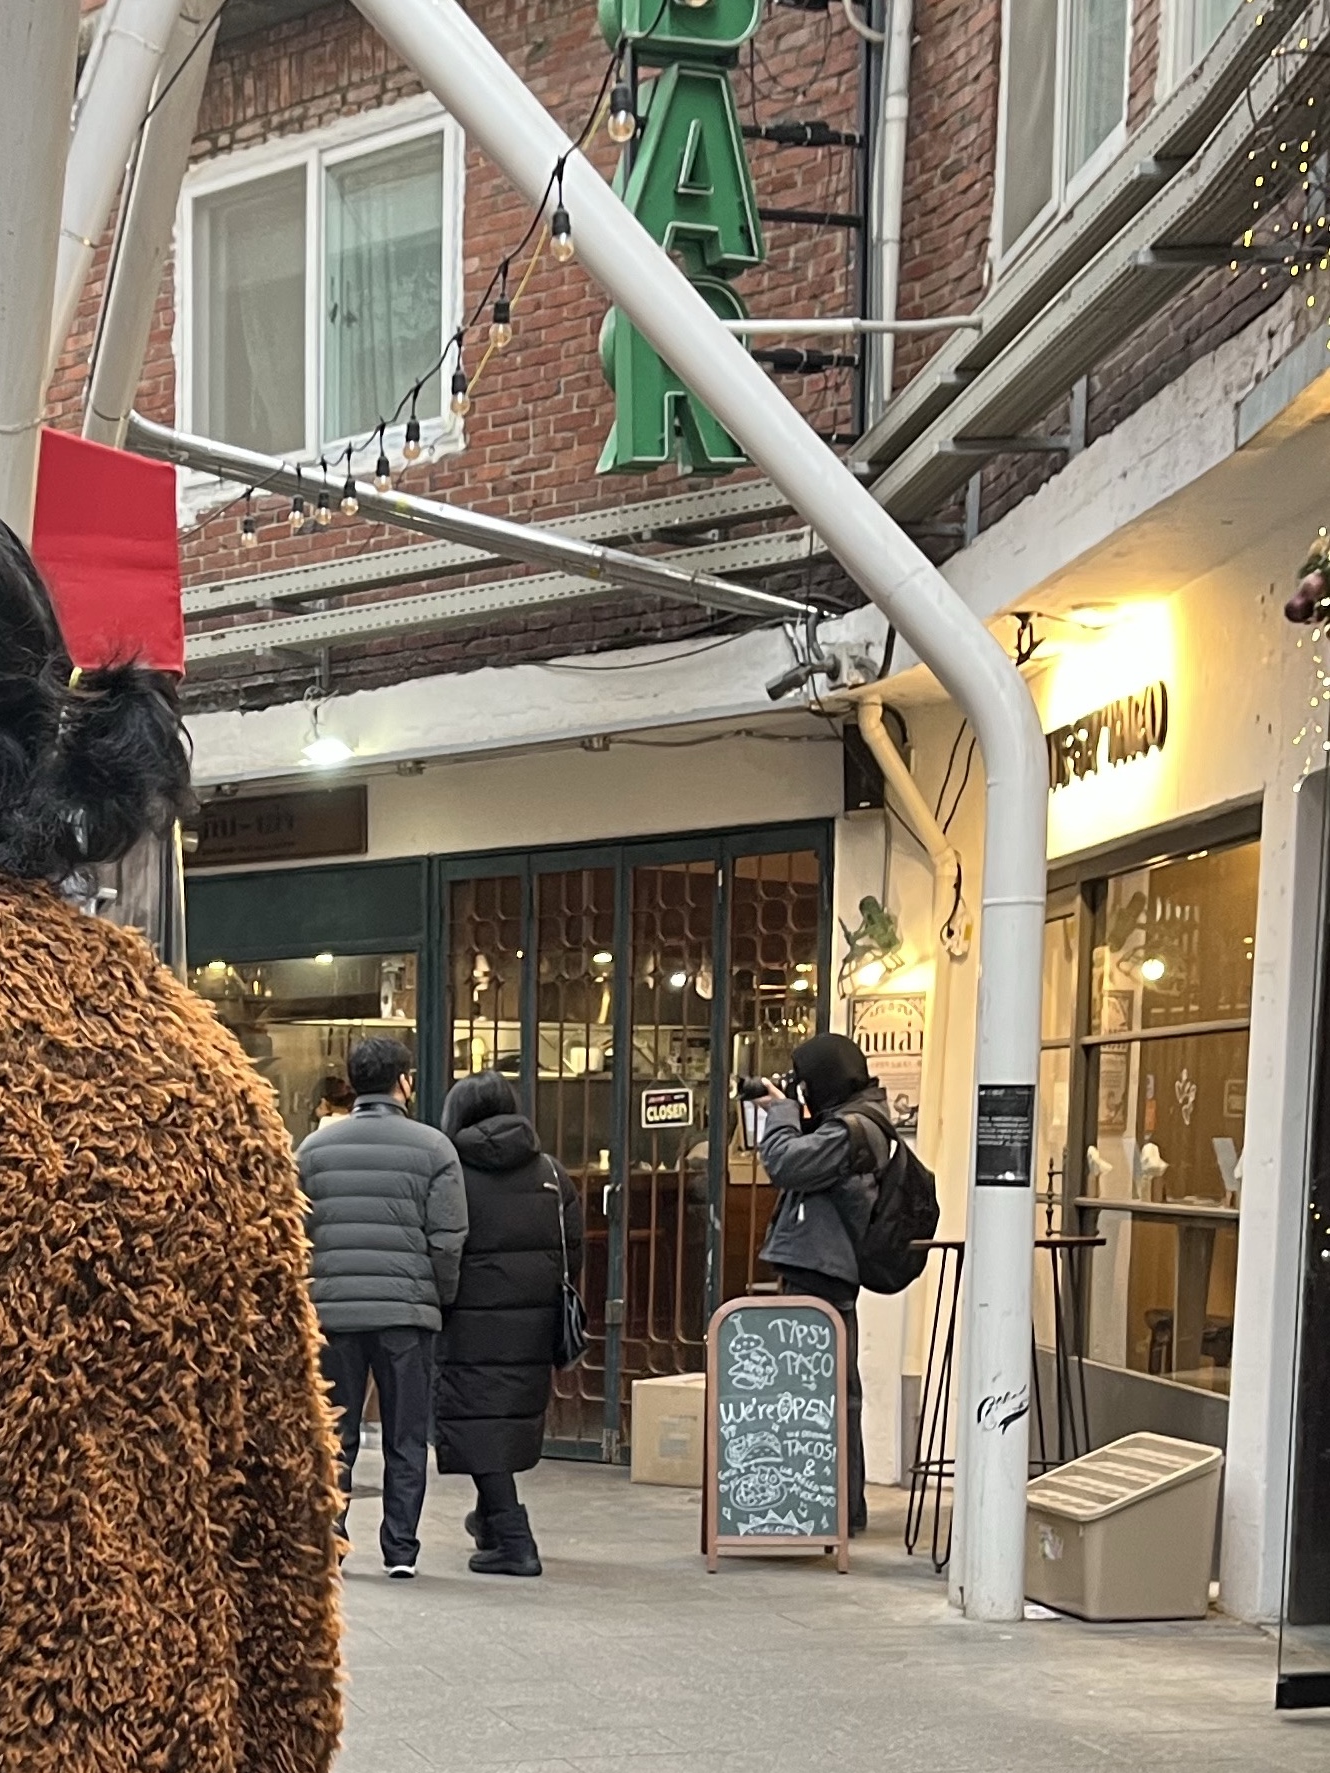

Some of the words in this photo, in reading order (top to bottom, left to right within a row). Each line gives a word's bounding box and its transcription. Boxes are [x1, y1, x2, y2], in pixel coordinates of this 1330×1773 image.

[646, 1102, 688, 1122] CLOSED
[778, 1350, 835, 1378] TACO
[776, 1394, 835, 1423] OPEN
[802, 1458, 816, 1477] &
